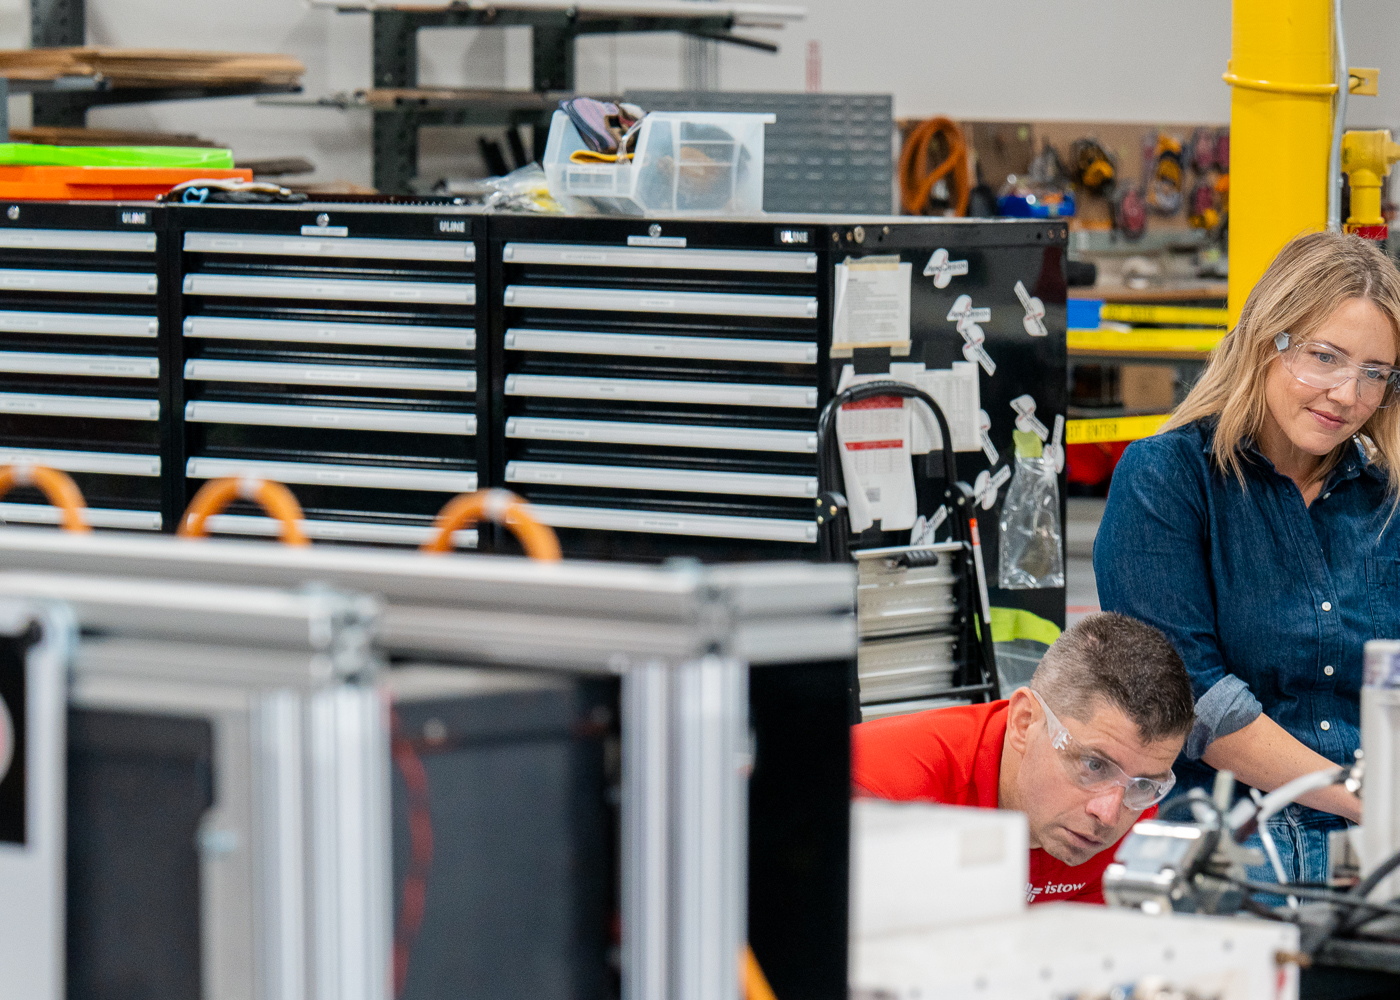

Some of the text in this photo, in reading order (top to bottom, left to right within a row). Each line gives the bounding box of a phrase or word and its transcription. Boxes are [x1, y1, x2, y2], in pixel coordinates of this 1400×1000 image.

[121, 211, 148, 225] ULINE
[439, 220, 466, 233] ULINE
[779, 230, 809, 244] ULINE
